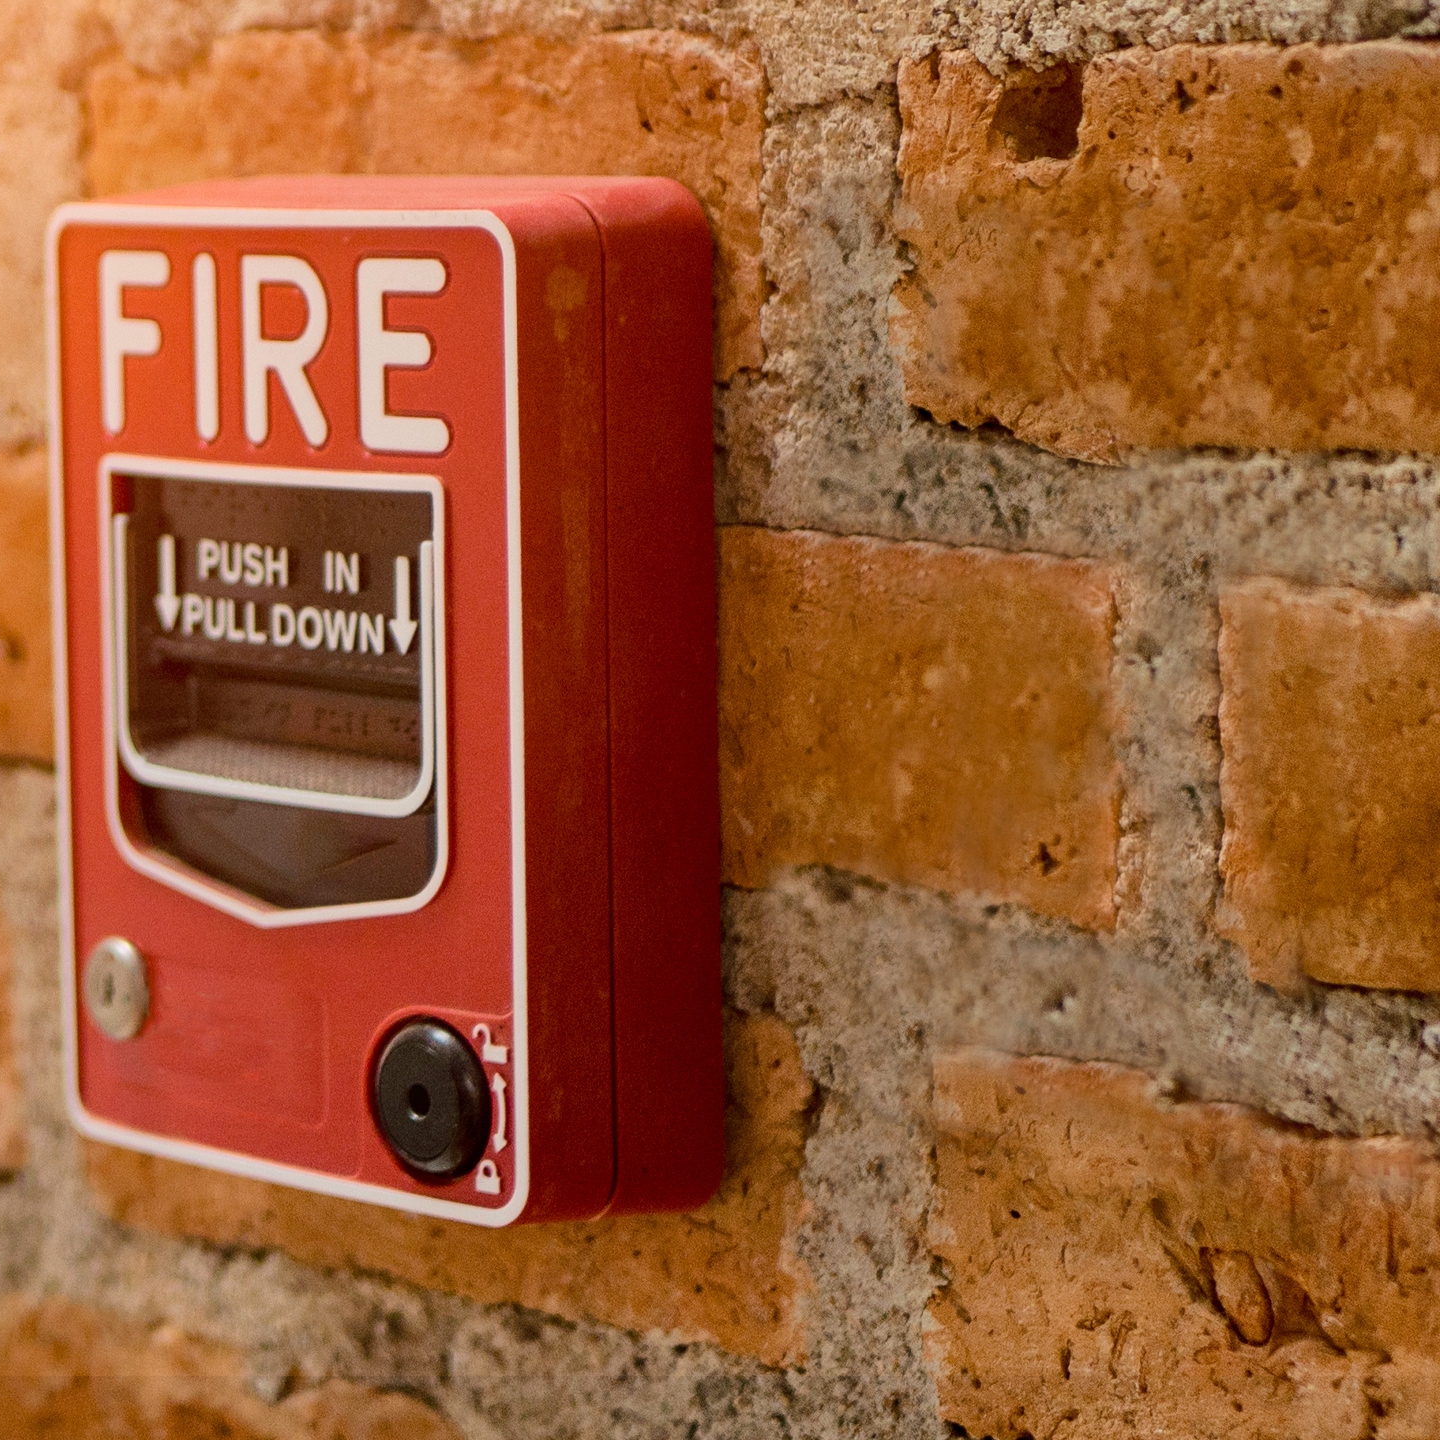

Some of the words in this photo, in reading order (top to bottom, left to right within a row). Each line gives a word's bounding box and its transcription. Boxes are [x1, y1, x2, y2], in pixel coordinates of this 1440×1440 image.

[101, 251, 450, 453] FIRE
[198, 538, 288, 587] PUSH
[324, 550, 359, 595] IN
[182, 593, 266, 644] PULL
[272, 603, 385, 655] DOWN
